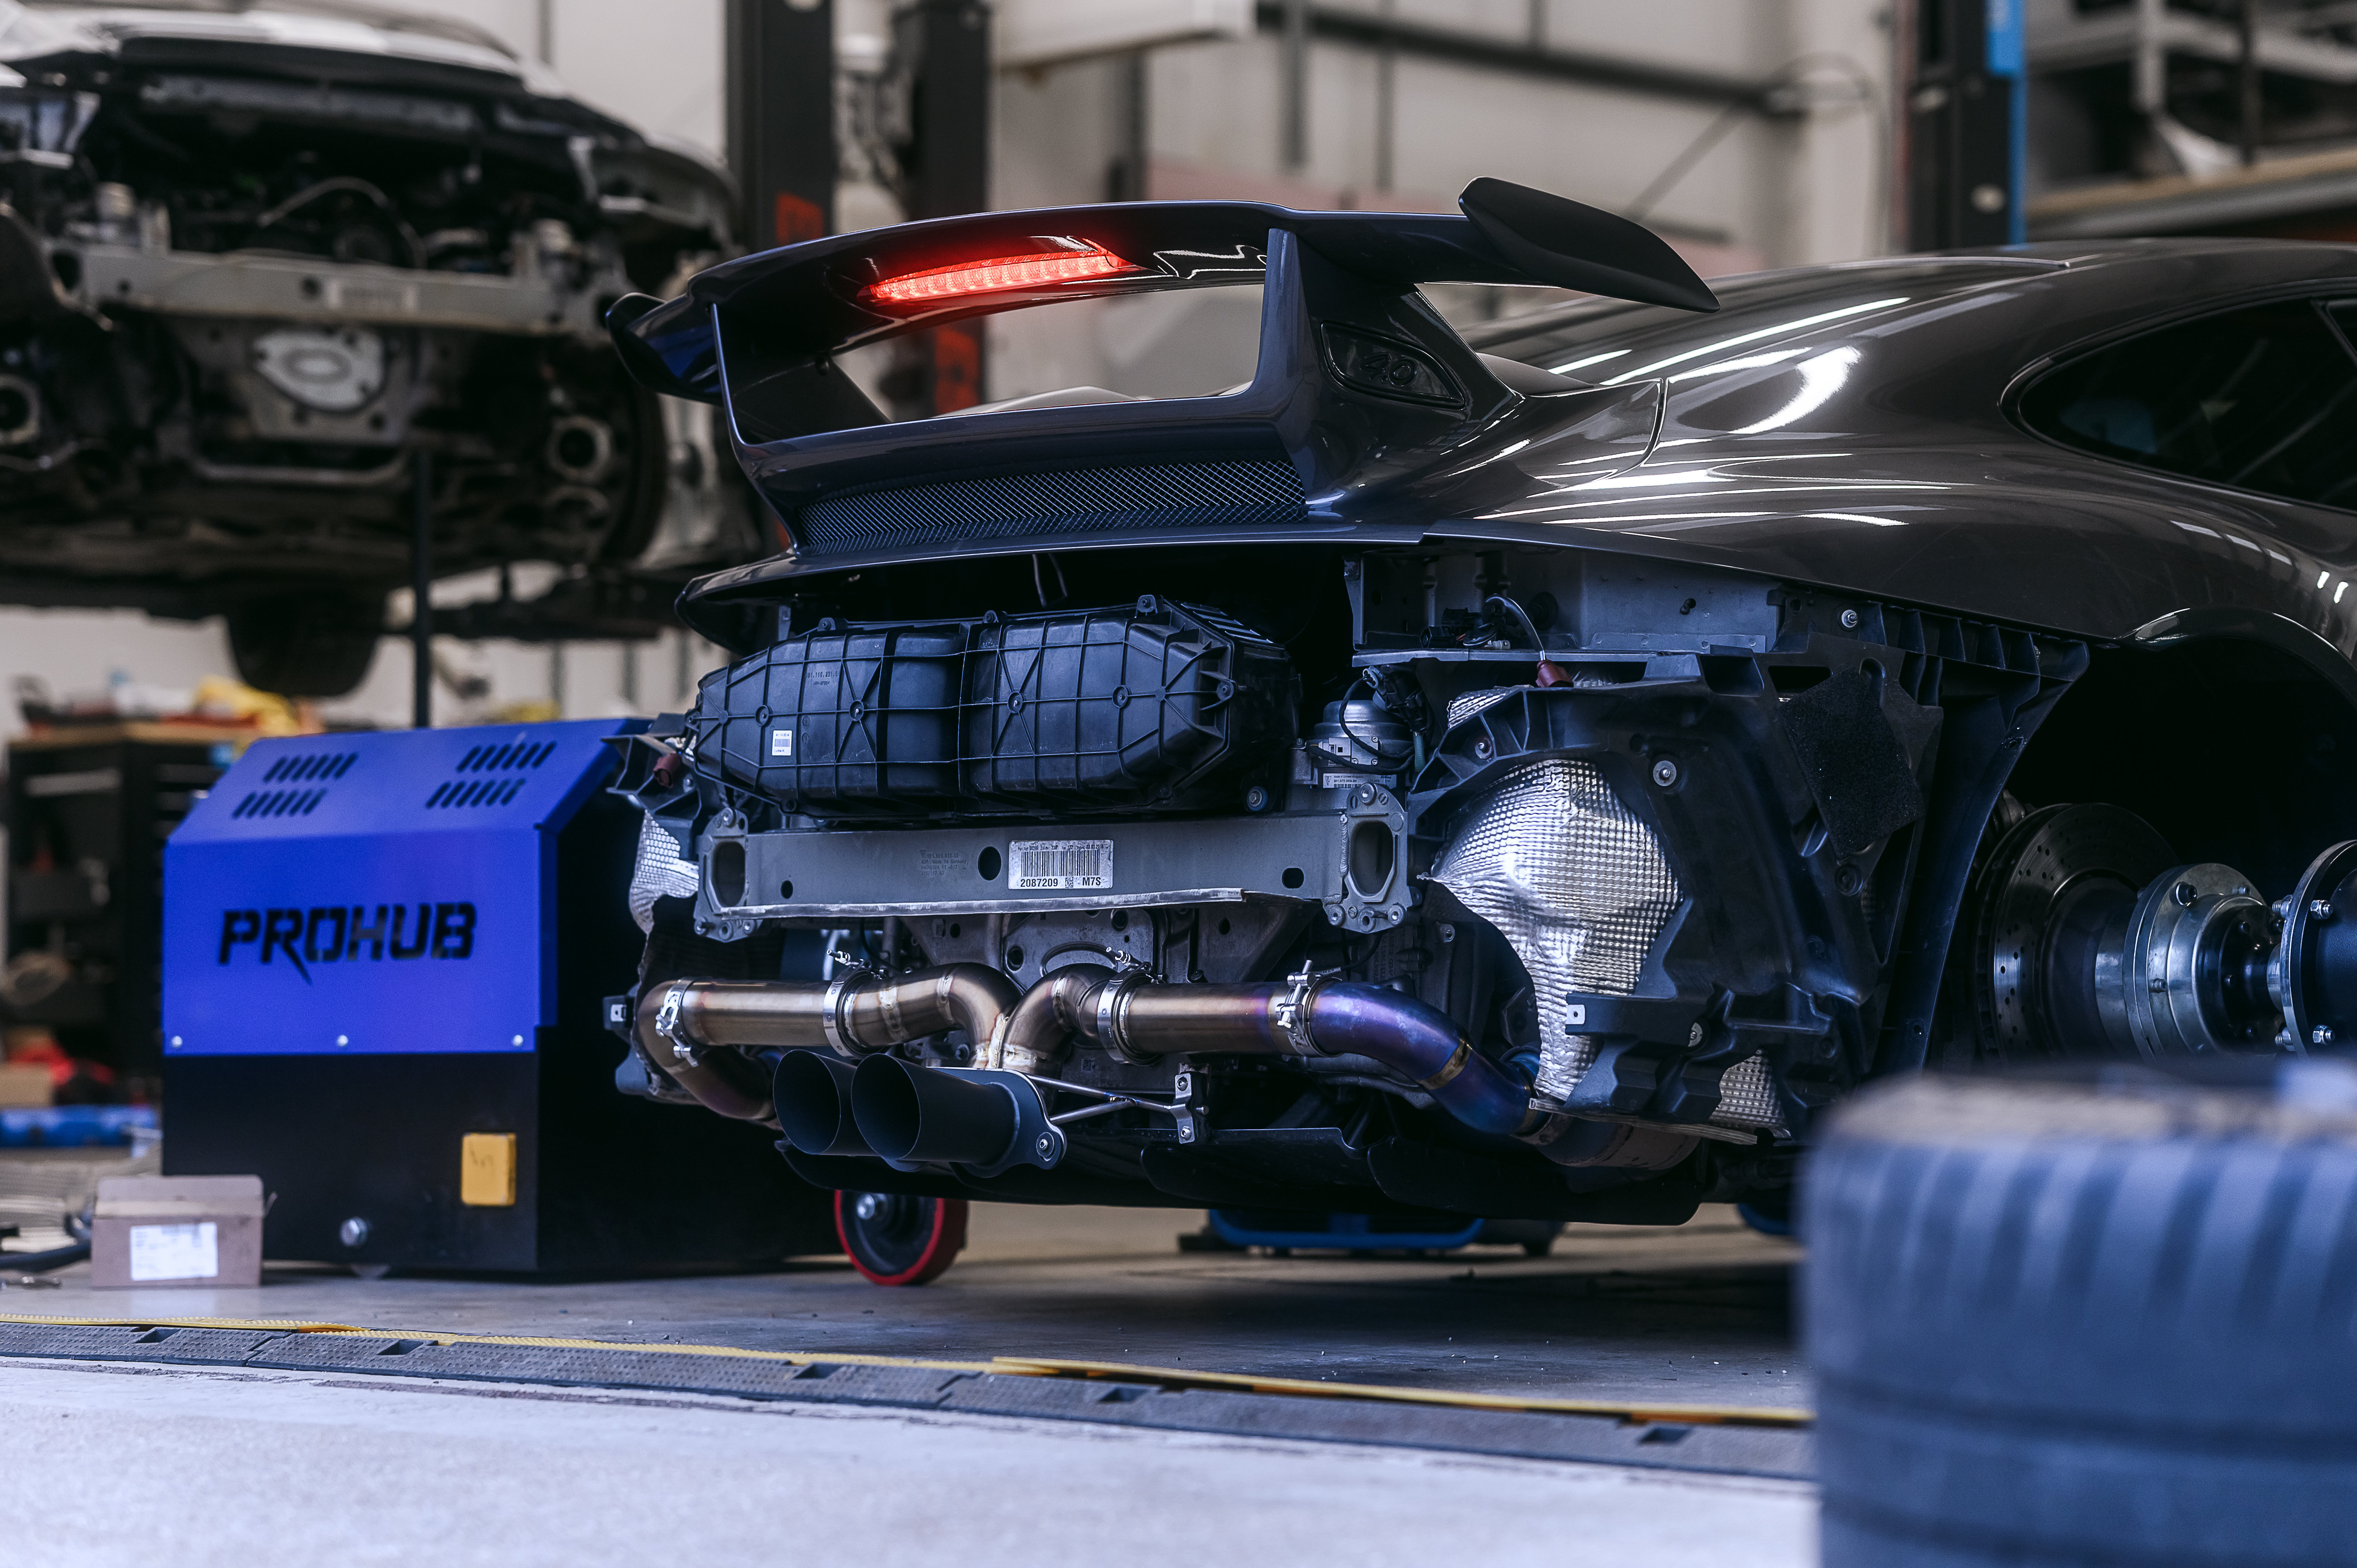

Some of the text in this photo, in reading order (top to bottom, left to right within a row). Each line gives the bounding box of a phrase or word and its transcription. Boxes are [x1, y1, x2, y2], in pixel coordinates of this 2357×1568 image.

[1020, 877, 1101, 887] 2087209 M7S
[217, 901, 477, 985] PROHUB
